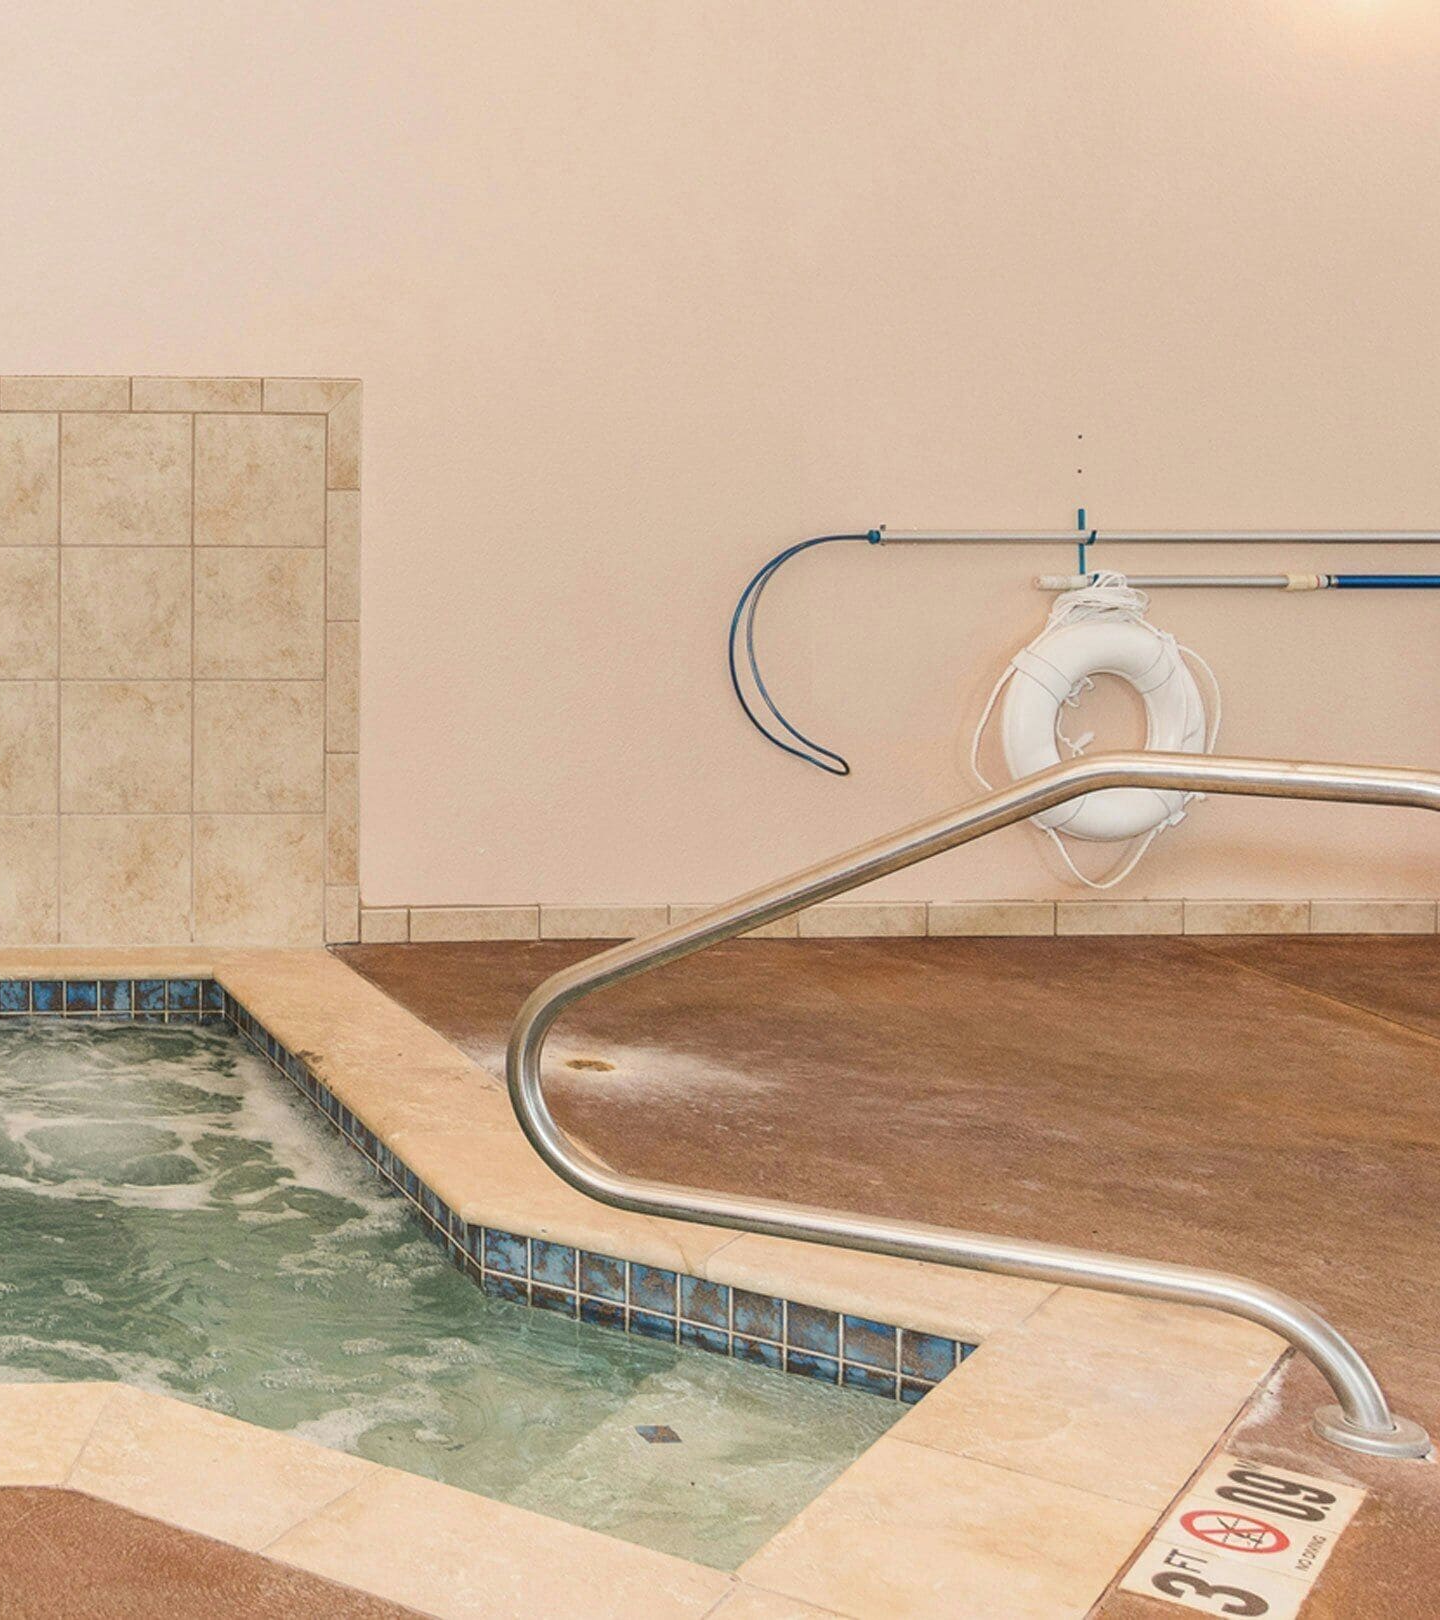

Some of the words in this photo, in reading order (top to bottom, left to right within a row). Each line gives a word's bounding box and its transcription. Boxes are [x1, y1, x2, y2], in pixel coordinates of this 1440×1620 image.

[1302, 1534, 1327, 1560] DIVING
[1163, 1549, 1208, 1574] FT
[1295, 1558, 1312, 1572] NO
[1151, 1571, 1269, 1617] 3
